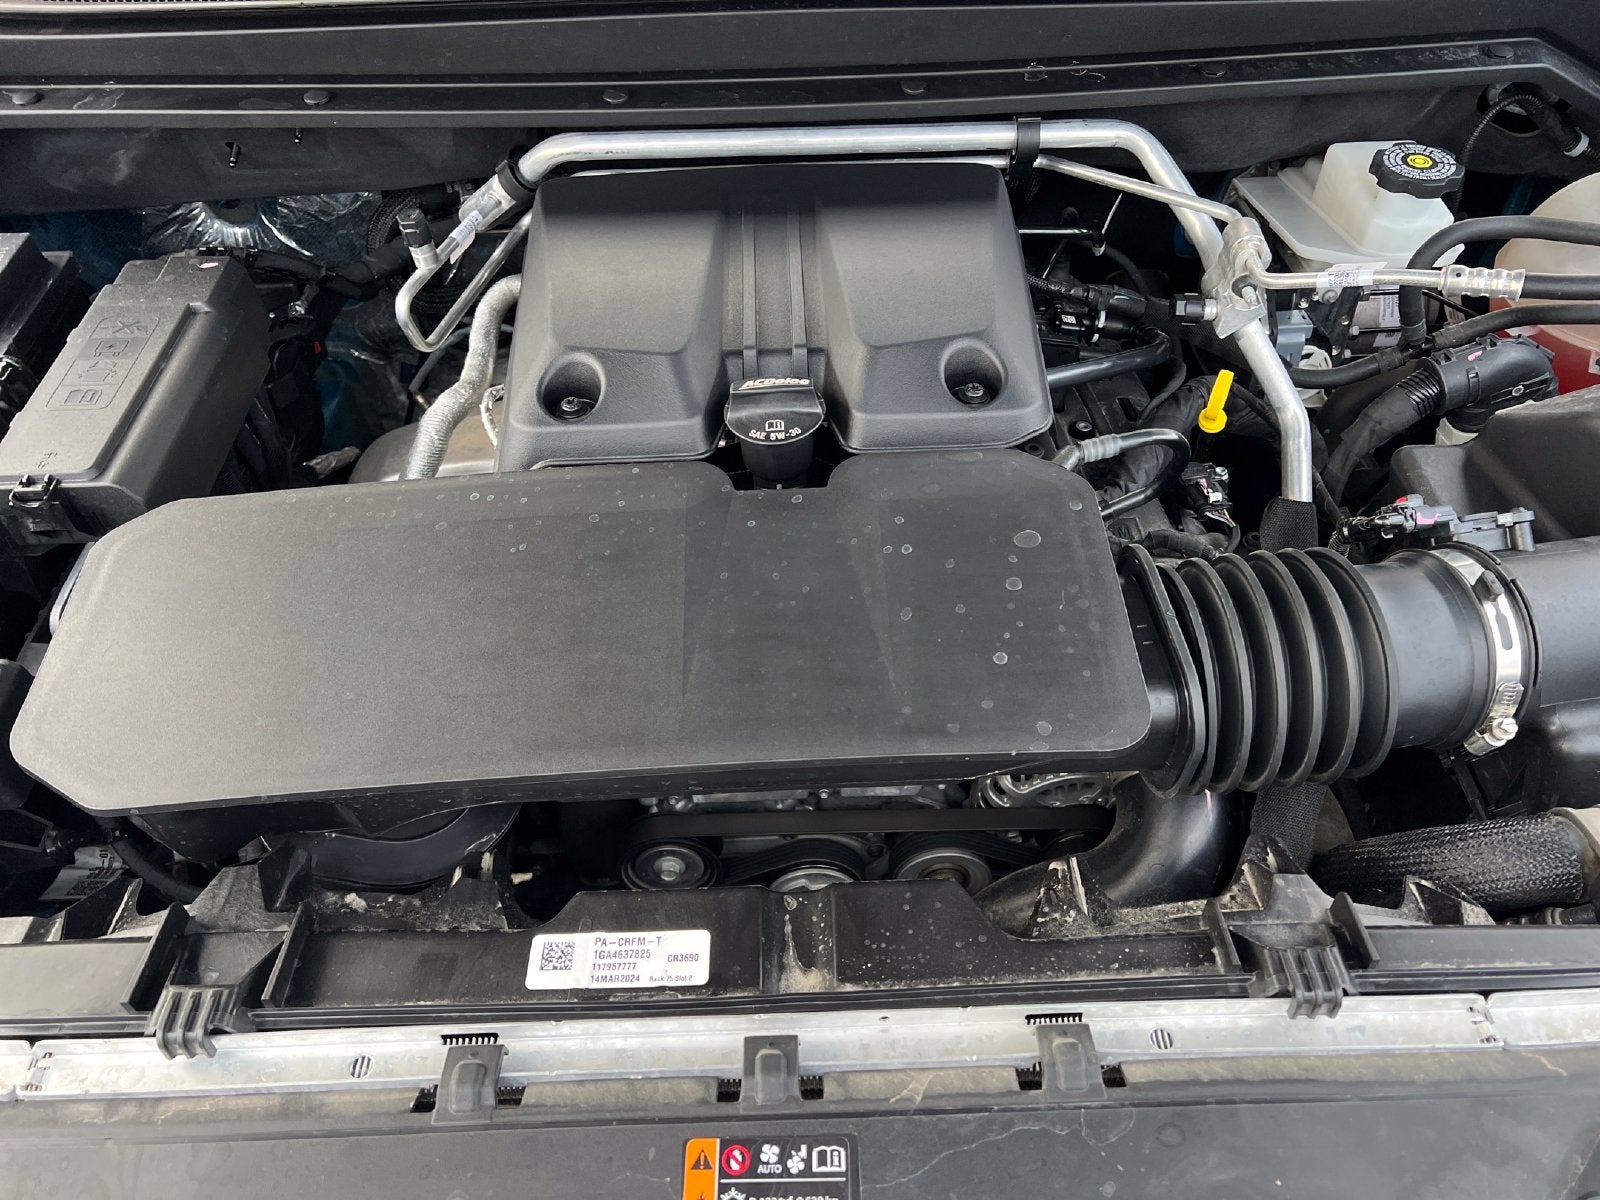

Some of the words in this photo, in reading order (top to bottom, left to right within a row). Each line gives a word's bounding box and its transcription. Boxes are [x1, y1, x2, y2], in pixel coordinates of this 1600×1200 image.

[739, 378, 810, 390] ACDelco
[748, 429, 767, 440] SAE
[769, 427, 801, 440] 5W-30
[594, 936, 663, 947] PA-CRFM-T
[594, 949, 652, 960] 1GA4637825
[667, 953, 700, 962] CR3690
[592, 962, 637, 971] 117957777
[590, 974, 640, 983] 14MAR2024
[757, 1164, 782, 1174] AUTO
